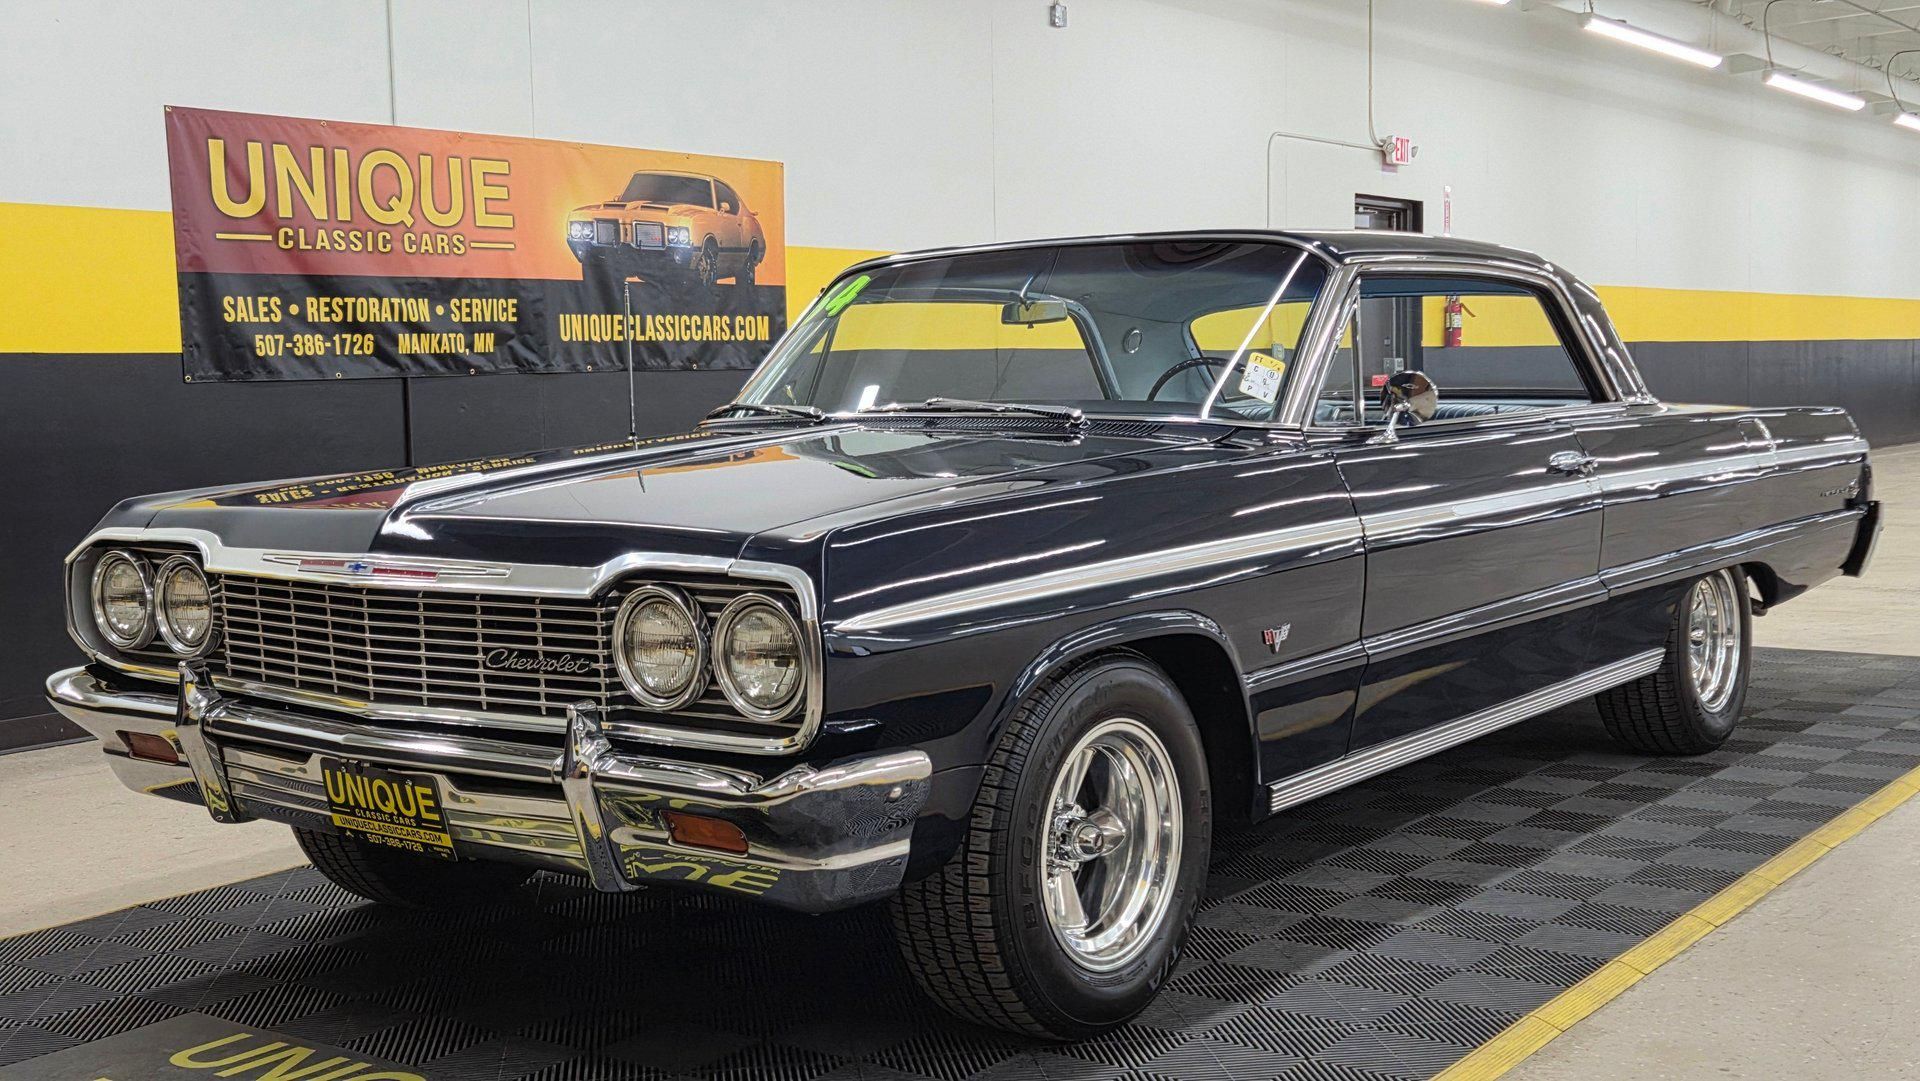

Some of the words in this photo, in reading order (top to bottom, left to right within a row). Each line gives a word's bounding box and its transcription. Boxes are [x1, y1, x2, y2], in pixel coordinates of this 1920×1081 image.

[1395, 136, 1409, 163] EXIT
[207, 138, 514, 229] UNIQUE
[278, 227, 392, 252] CLASSIC
[404, 232, 466, 255] CARS
[223, 295, 282, 323] SALES
[306, 296, 430, 323] RESTORATION
[450, 298, 518, 322] SERVICE
[559, 314, 770, 343] UNIQUECLASSICCARS.COM
[255, 333, 375, 357] 507-386-1726
[398, 333, 470, 356] MANKATO,
[474, 333, 495, 353] MN
[485, 648, 590, 673] Chevrolet
[324, 769, 440, 821] UNIQUE
[339, 816, 443, 844] UNIQUECLASSICCARS.COM
[355, 808, 391, 823] CLASSIC
[394, 816, 417, 827] CARS
